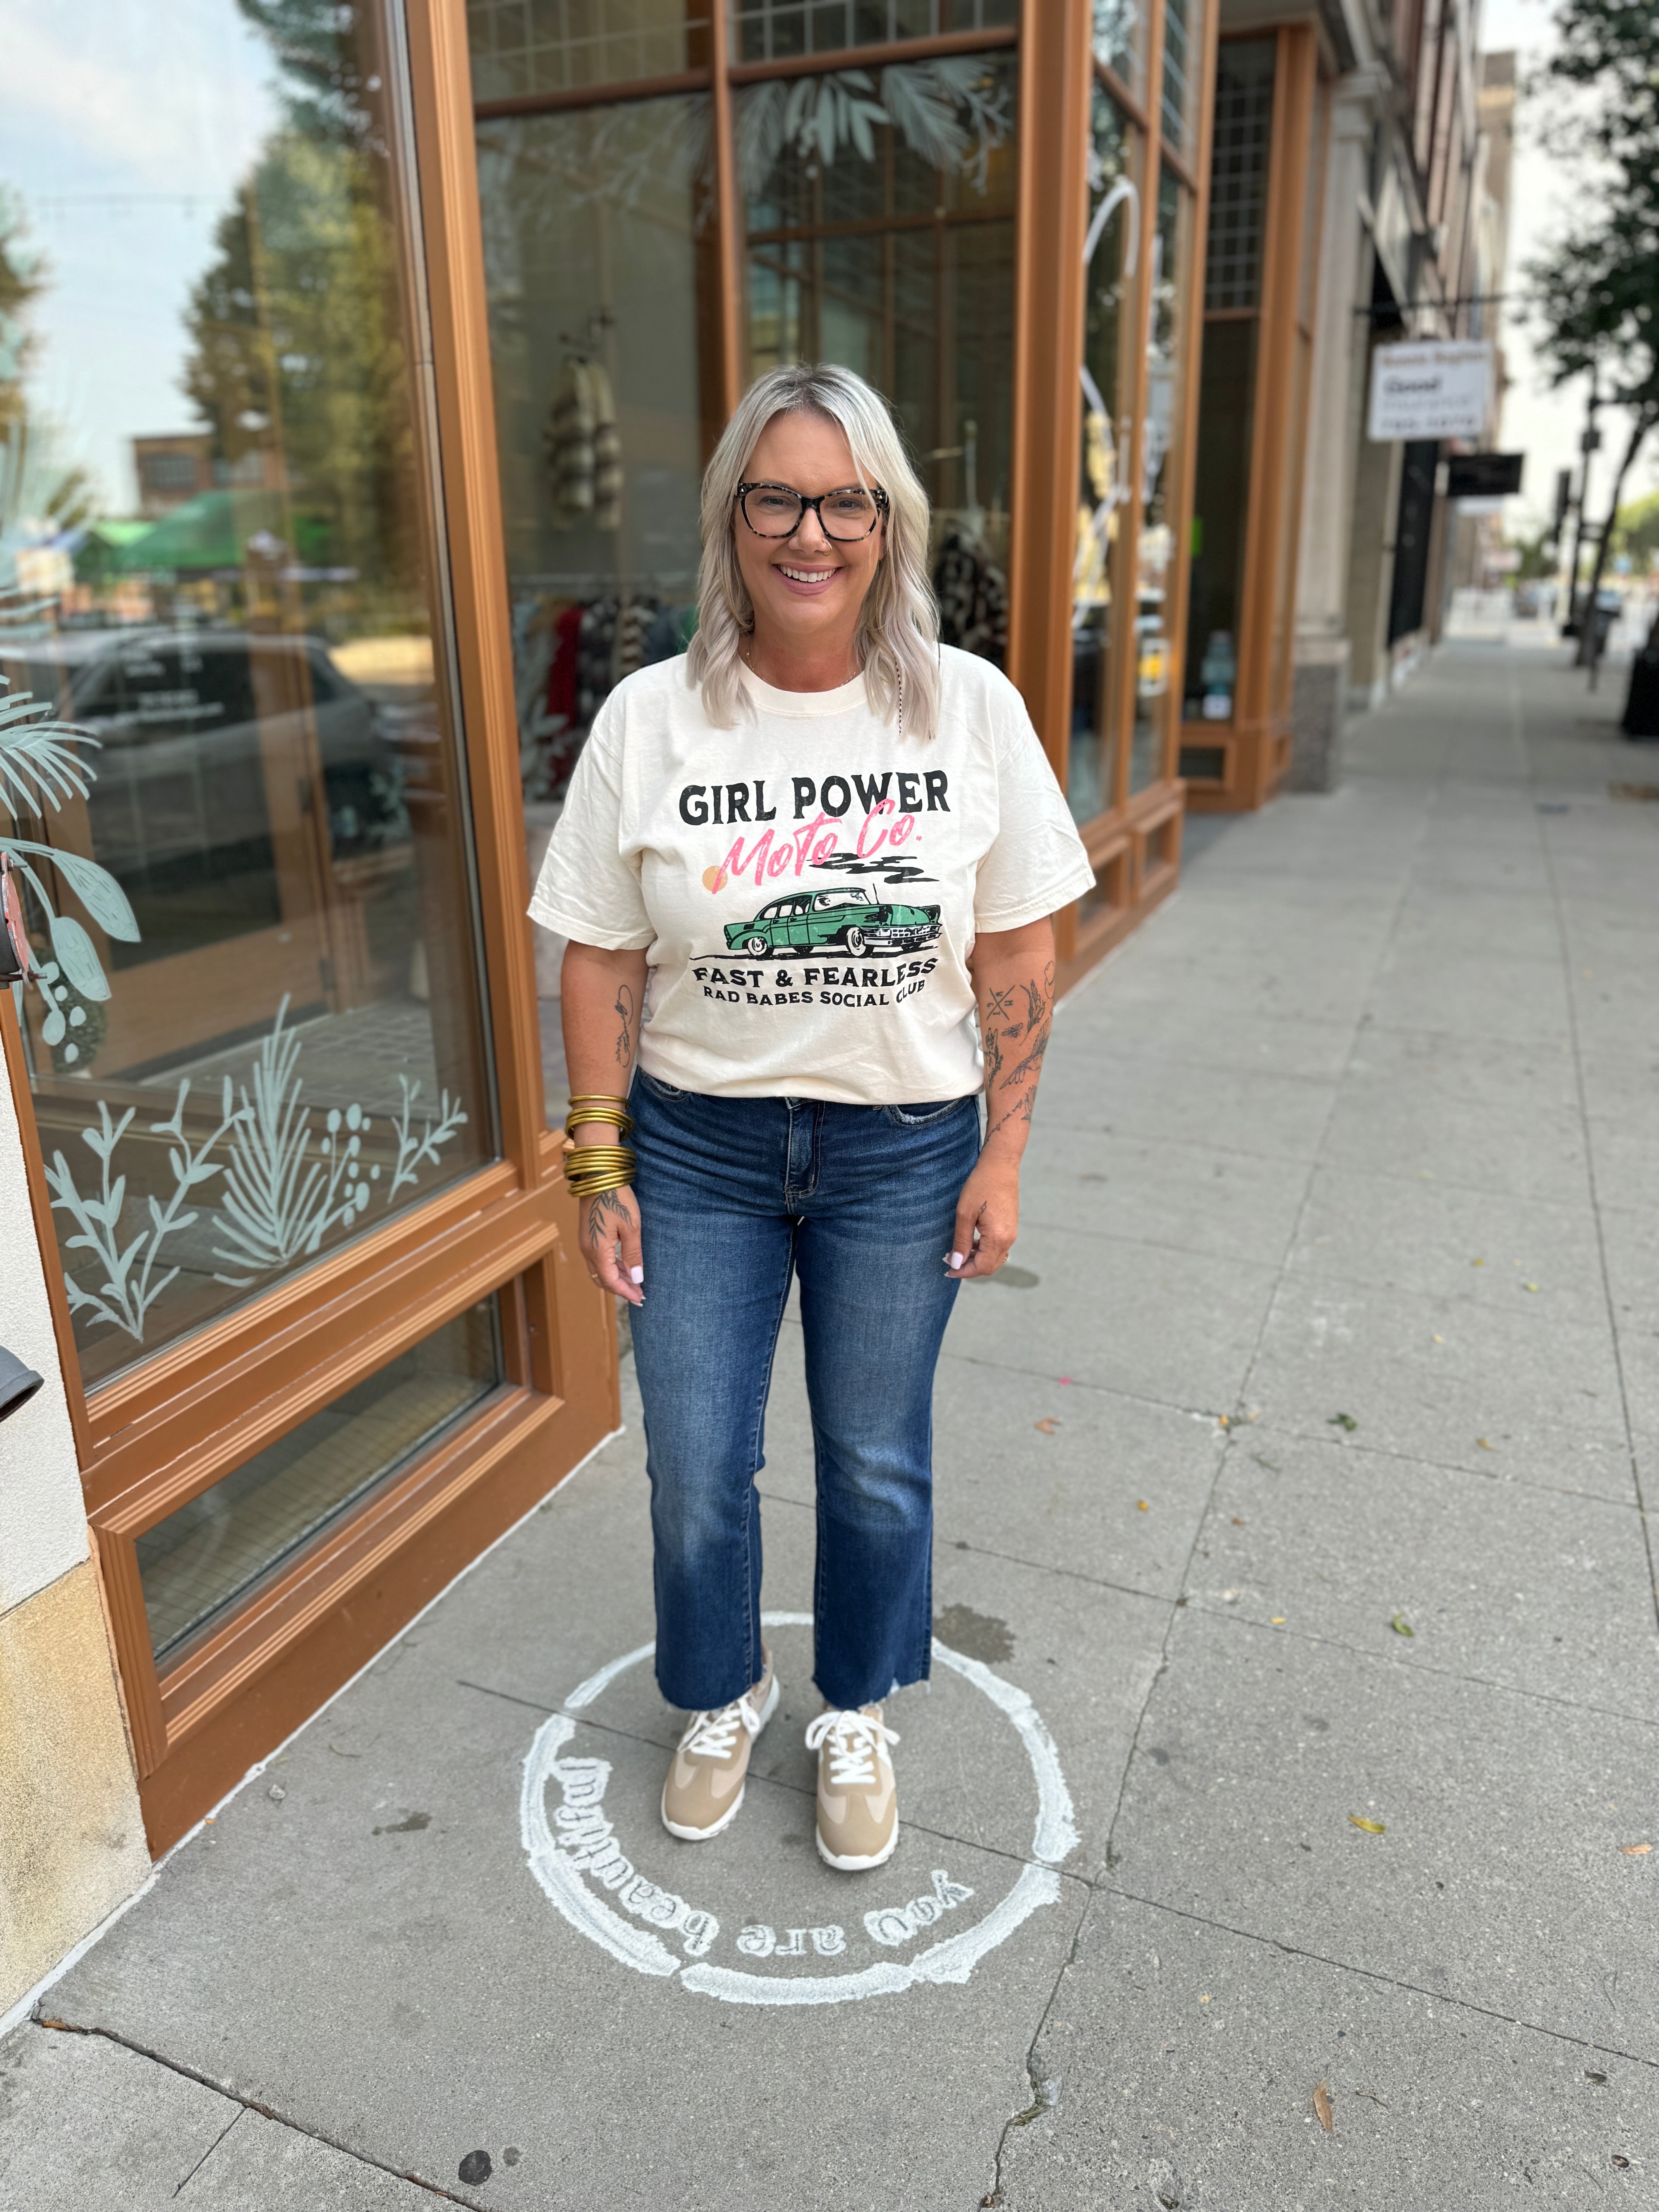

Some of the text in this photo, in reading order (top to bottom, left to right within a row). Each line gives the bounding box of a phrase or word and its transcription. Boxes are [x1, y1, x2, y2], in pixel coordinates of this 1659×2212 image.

[679, 770, 951, 826] GIRL POWER
[857, 798, 922, 859] Co.
[692, 957, 938, 988] FAST & FEARLESS
[703, 979, 926, 1008] RAD BABES SOCIAL CLUB
[553, 1757, 720, 1956] beautiful
[737, 1924, 846, 1958] are
